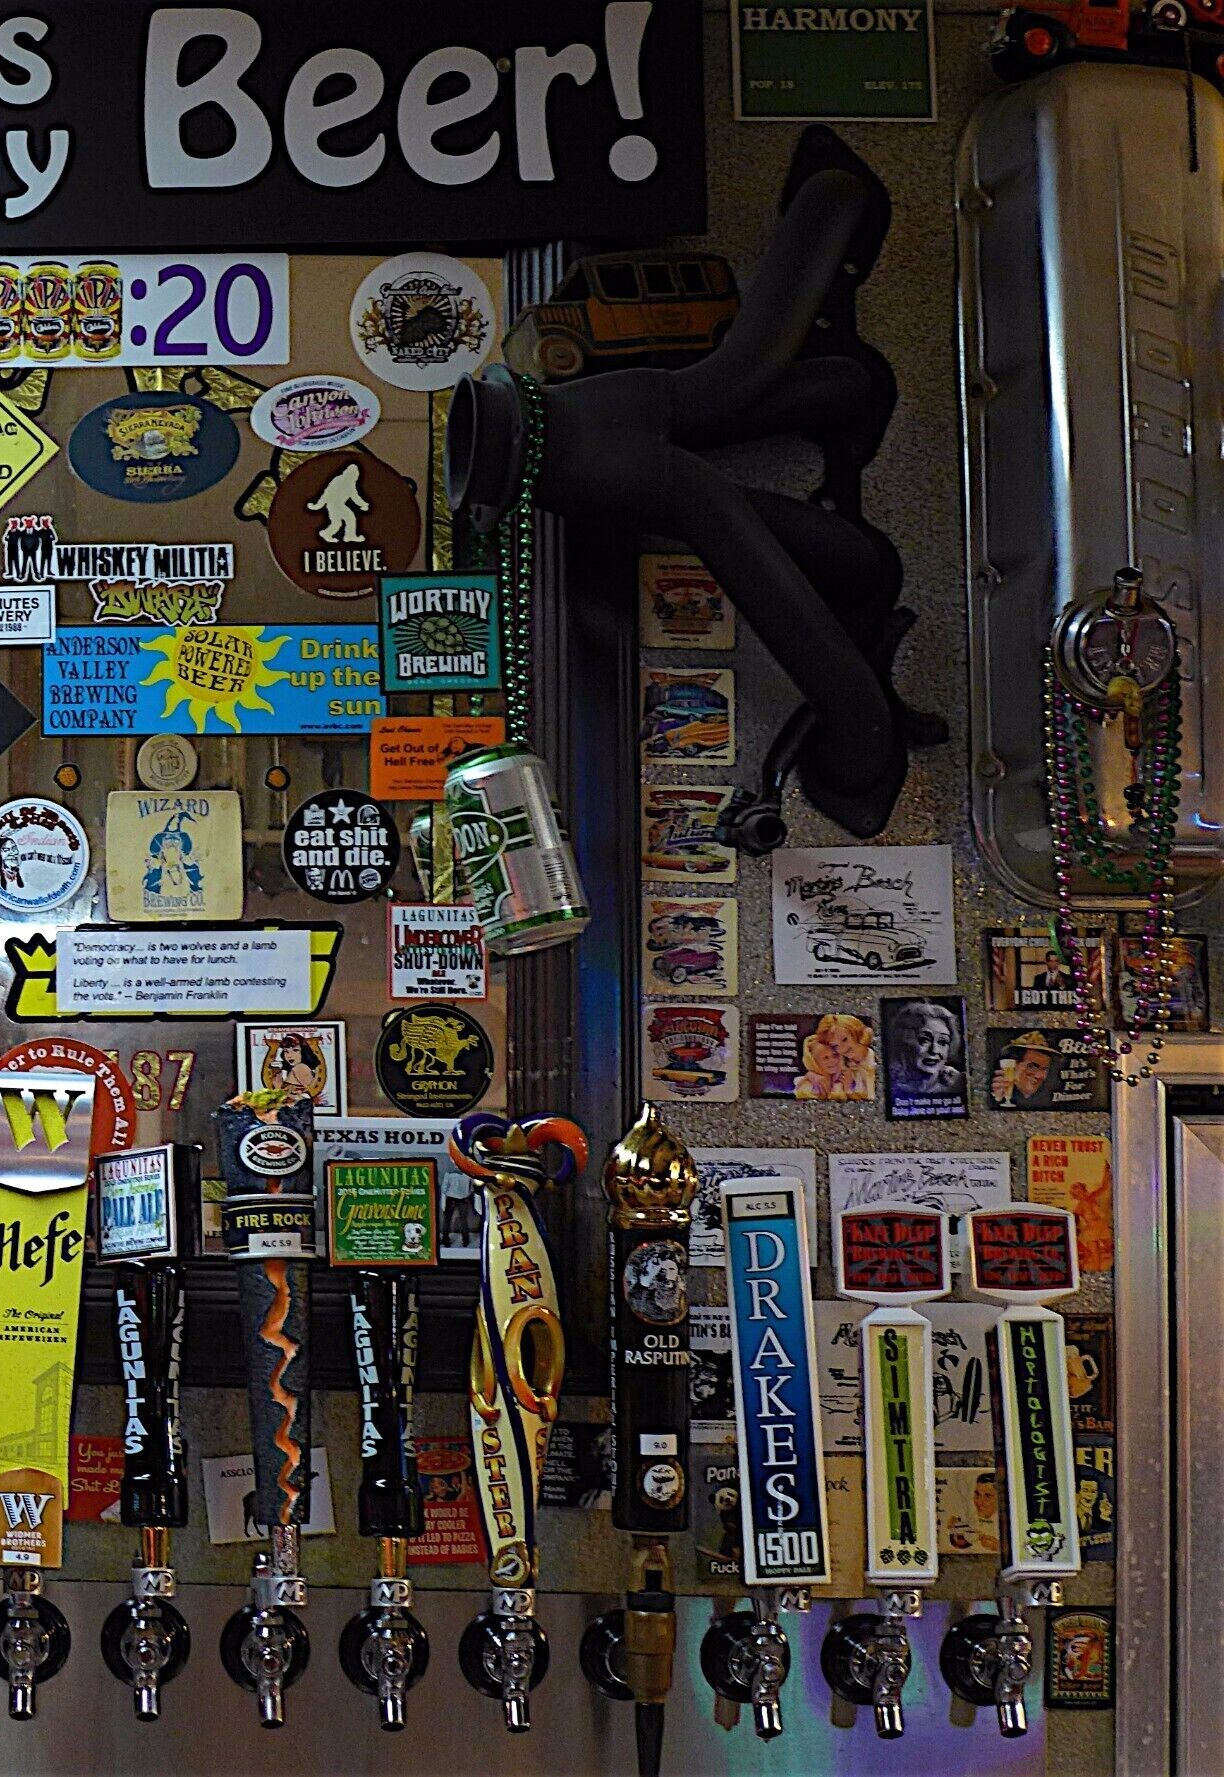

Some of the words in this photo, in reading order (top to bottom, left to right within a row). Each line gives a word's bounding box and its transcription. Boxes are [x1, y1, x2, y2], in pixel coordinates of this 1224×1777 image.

[743, 8, 923, 32] HARMONY
[144, 2, 658, 188] Beer!
[56, 546, 150, 577] WHISKEY
[153, 546, 231, 578] MILITIA
[304, 551, 310, 572] I
[316, 550, 388, 572] BELIEVE.
[389, 588, 492, 624] WORTHY
[46, 636, 141, 656] ANDERSON
[183, 629, 254, 659] SOLAR
[300, 638, 379, 660] Drink
[57, 660, 130, 680] VALLEY
[177, 644, 251, 677] POWERED
[397, 652, 487, 678] BREWING
[177, 662, 245, 694] BEER
[289, 670, 325, 692] up
[331, 666, 380, 686] the
[50, 685, 137, 705] BREWING
[328, 698, 382, 717] sun
[49, 709, 137, 729] COMPANY
[294, 829, 335, 846] eat
[339, 827, 388, 846] shit
[292, 847, 340, 866] and
[344, 847, 391, 866] die.
[313, 1129, 378, 1144] TEXAS
[384, 1130, 445, 1144] HOLD
[1031, 1140, 1066, 1152] NEVER
[1070, 1140, 1103, 1153] TRUST
[1032, 1156, 1042, 1167] A
[1043, 1155, 1069, 1168] RICH
[1032, 1170, 1065, 1183] BITCH
[236, 1214, 272, 1228] FIRE
[274, 1213, 311, 1226] ROCK
[644, 1334, 680, 1349] OLD
[624, 1349, 691, 1367] RASPUTIN
[117, 1289, 149, 1455] LAGUNITAS
[742, 1231, 799, 1523] DRAKES
[882, 1328, 916, 1546] SIMTRA
[757, 1531, 819, 1566] 1500
